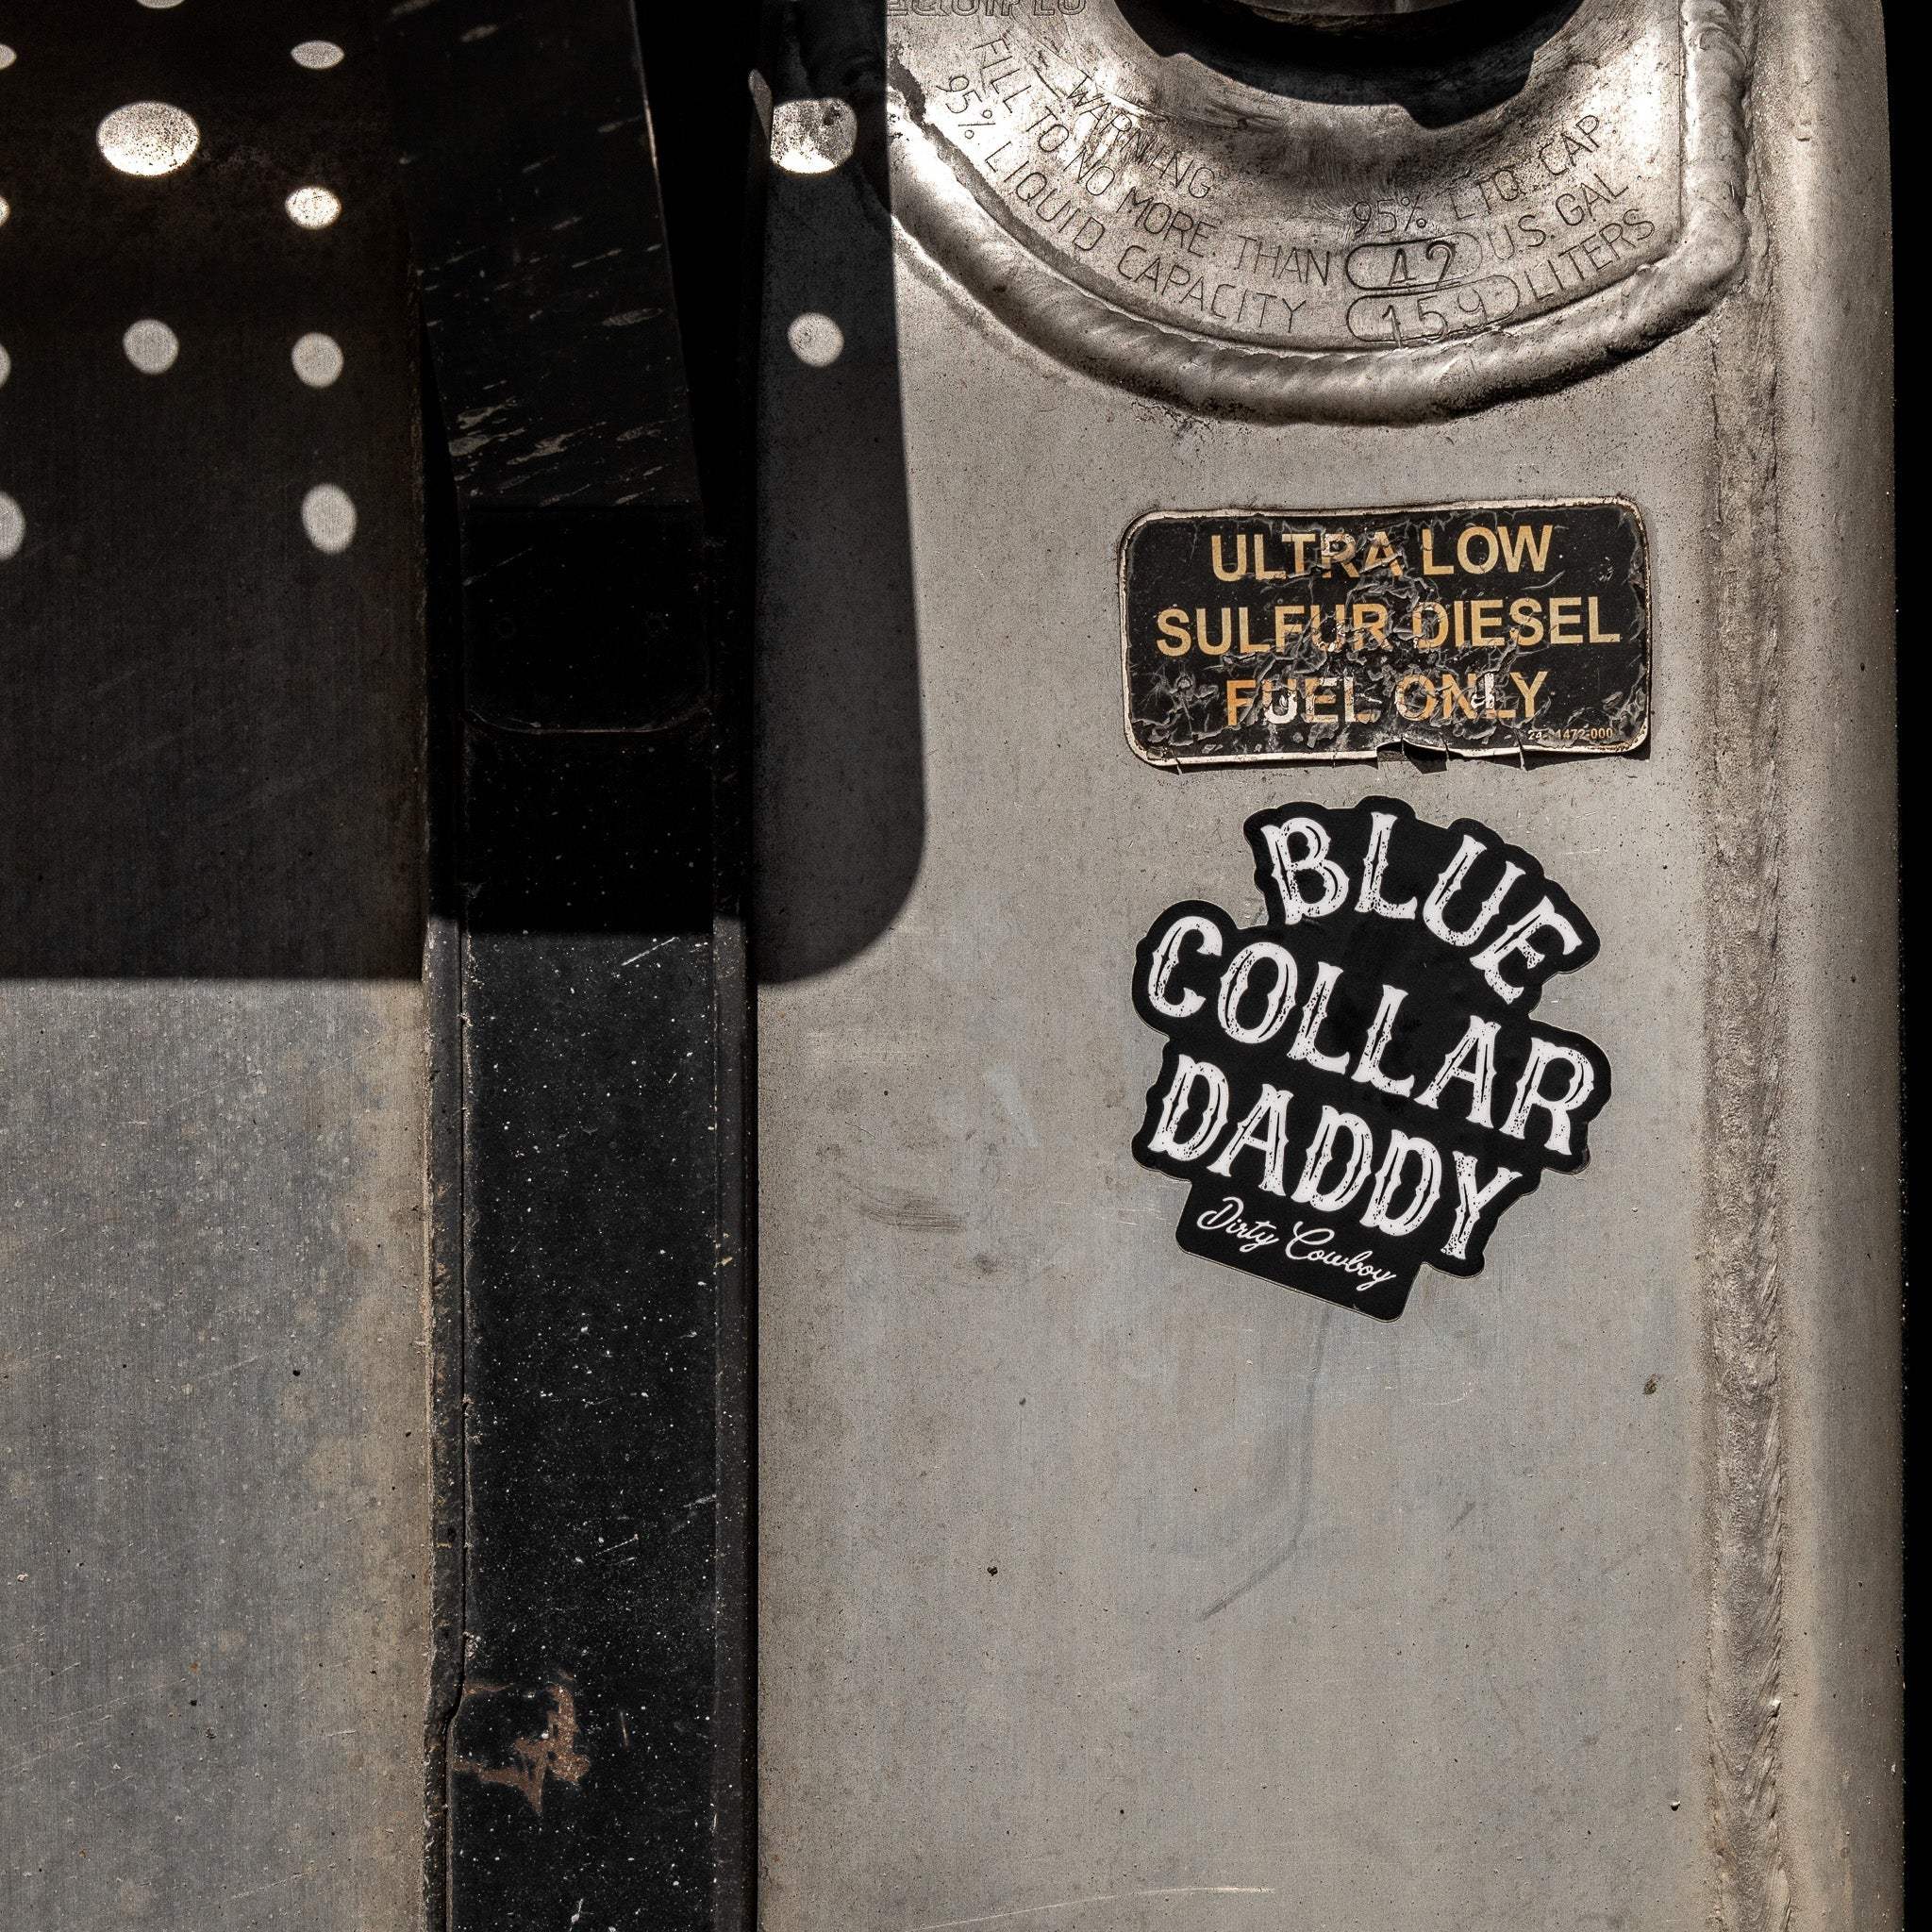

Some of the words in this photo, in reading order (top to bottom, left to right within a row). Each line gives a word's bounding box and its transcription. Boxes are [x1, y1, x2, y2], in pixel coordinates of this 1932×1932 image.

[973, 36, 1032, 114] FILL
[1025, 106, 1070, 153] TO
[1063, 142, 1116, 196] NO
[1116, 186, 1217, 258] MORE
[1233, 234, 1330, 285] THAN
[1067, 74, 1215, 199] WARNING
[1352, 194, 1428, 236] 95%
[1539, 113, 1601, 176] CAP
[935, 75, 996, 141] 95%
[984, 140, 1108, 253] LIQUID
[1117, 244, 1307, 333] CAPACITY
[1554, 173, 1629, 226] GAL
[1381, 287, 1489, 348] 159
[1523, 208, 1657, 302] LITERS
[1210, 530, 1406, 583] ULTRA
[1422, 524, 1554, 576] LOW
[1155, 604, 1396, 658] SULFUR
[1412, 596, 1622, 649] DIESEL
[1225, 677, 1376, 726] FUEL
[1395, 671, 1548, 721] ONLY
[1259, 811, 1583, 1006] BLUE
[1146, 914, 1596, 1156] COLLAR
[1146, 1052, 1524, 1260] DADDY
[1196, 1195, 1280, 1254] Dirty
[1285, 1220, 1397, 1292] Cowboy
